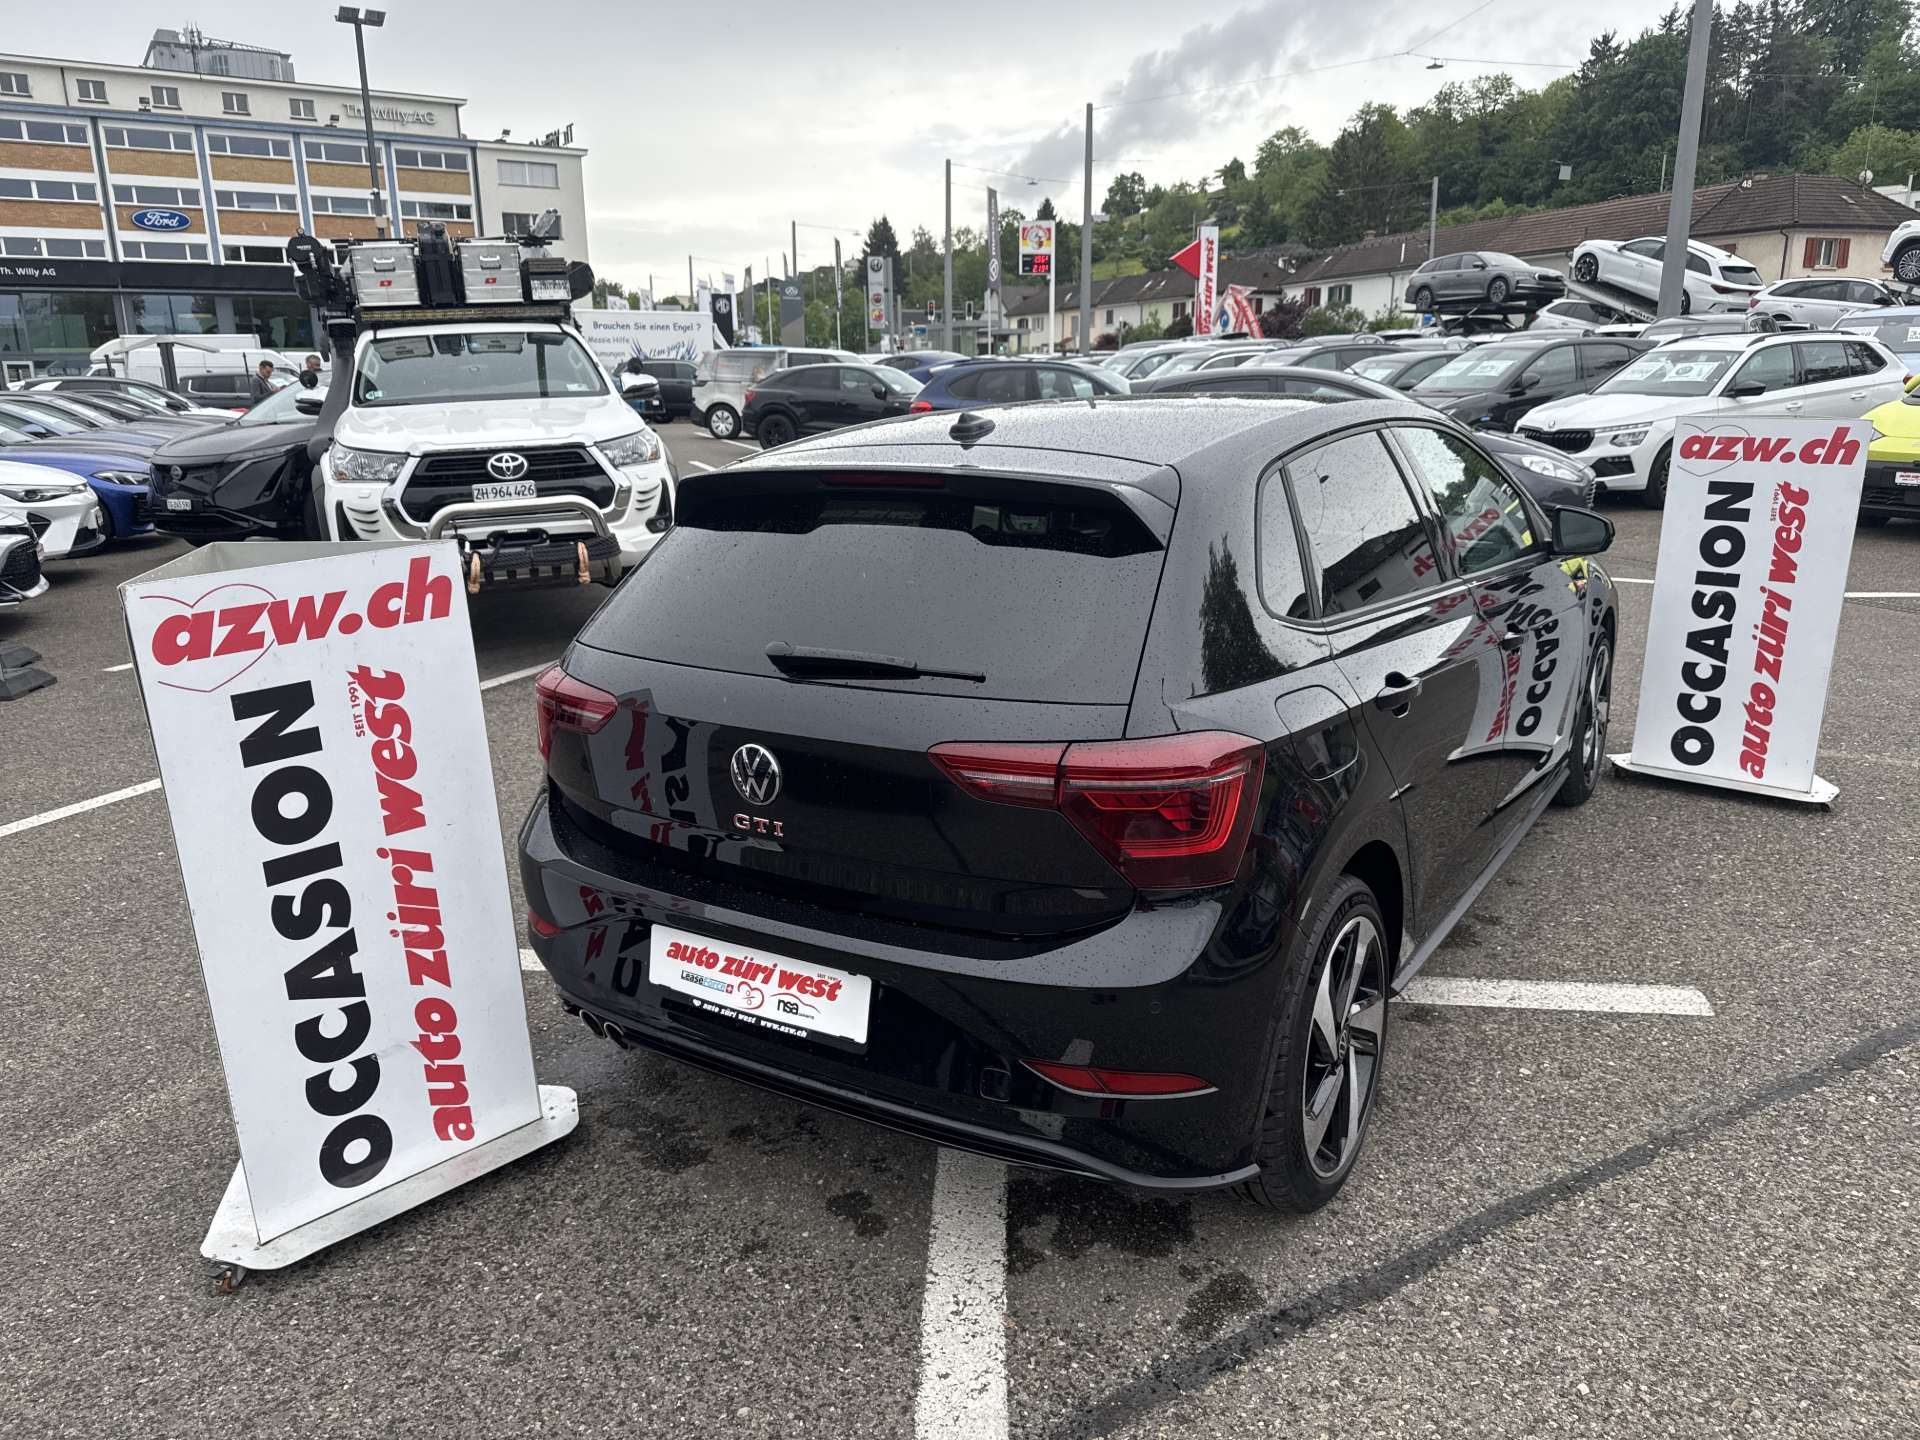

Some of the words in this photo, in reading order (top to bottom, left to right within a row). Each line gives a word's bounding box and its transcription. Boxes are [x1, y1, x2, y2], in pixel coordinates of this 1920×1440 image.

[371, 105, 409, 126] Willy
[412, 110, 437, 126] AG
[1741, 179, 1752, 188] 48
[143, 210, 180, 227] Ford
[15, 267, 39, 277] Willy
[42, 268, 57, 276] AG
[1204, 237, 1215, 273] west
[593, 320, 631, 331] Brauchen
[633, 322, 647, 331] Sie
[649, 322, 671, 331] einen
[673, 322, 694, 334] Engel
[1679, 426, 1861, 466] azw.ch
[514, 484, 535, 496] 426
[1768, 480, 1810, 584] west
[151, 555, 453, 666] azw.ch
[1670, 480, 1755, 767] OCCASION
[1751, 585, 1792, 684] züri
[347, 680, 360, 710] 1991
[353, 713, 366, 738] SEIT
[1738, 681, 1778, 780] auto
[345, 664, 428, 837] west
[733, 813, 785, 838] GTI
[230, 679, 394, 1189] OCCASION
[376, 846, 453, 989] züri
[666, 941, 720, 970] auto
[718, 955, 778, 985] züri
[778, 969, 843, 1002] west
[702, 1003, 720, 1013] auto
[720, 1008, 738, 1018] züri
[738, 1013, 757, 1024] west
[760, 1020, 808, 1038] www.azw.ch
[777, 998, 799, 1015] nsa
[409, 997, 476, 1142] auto
